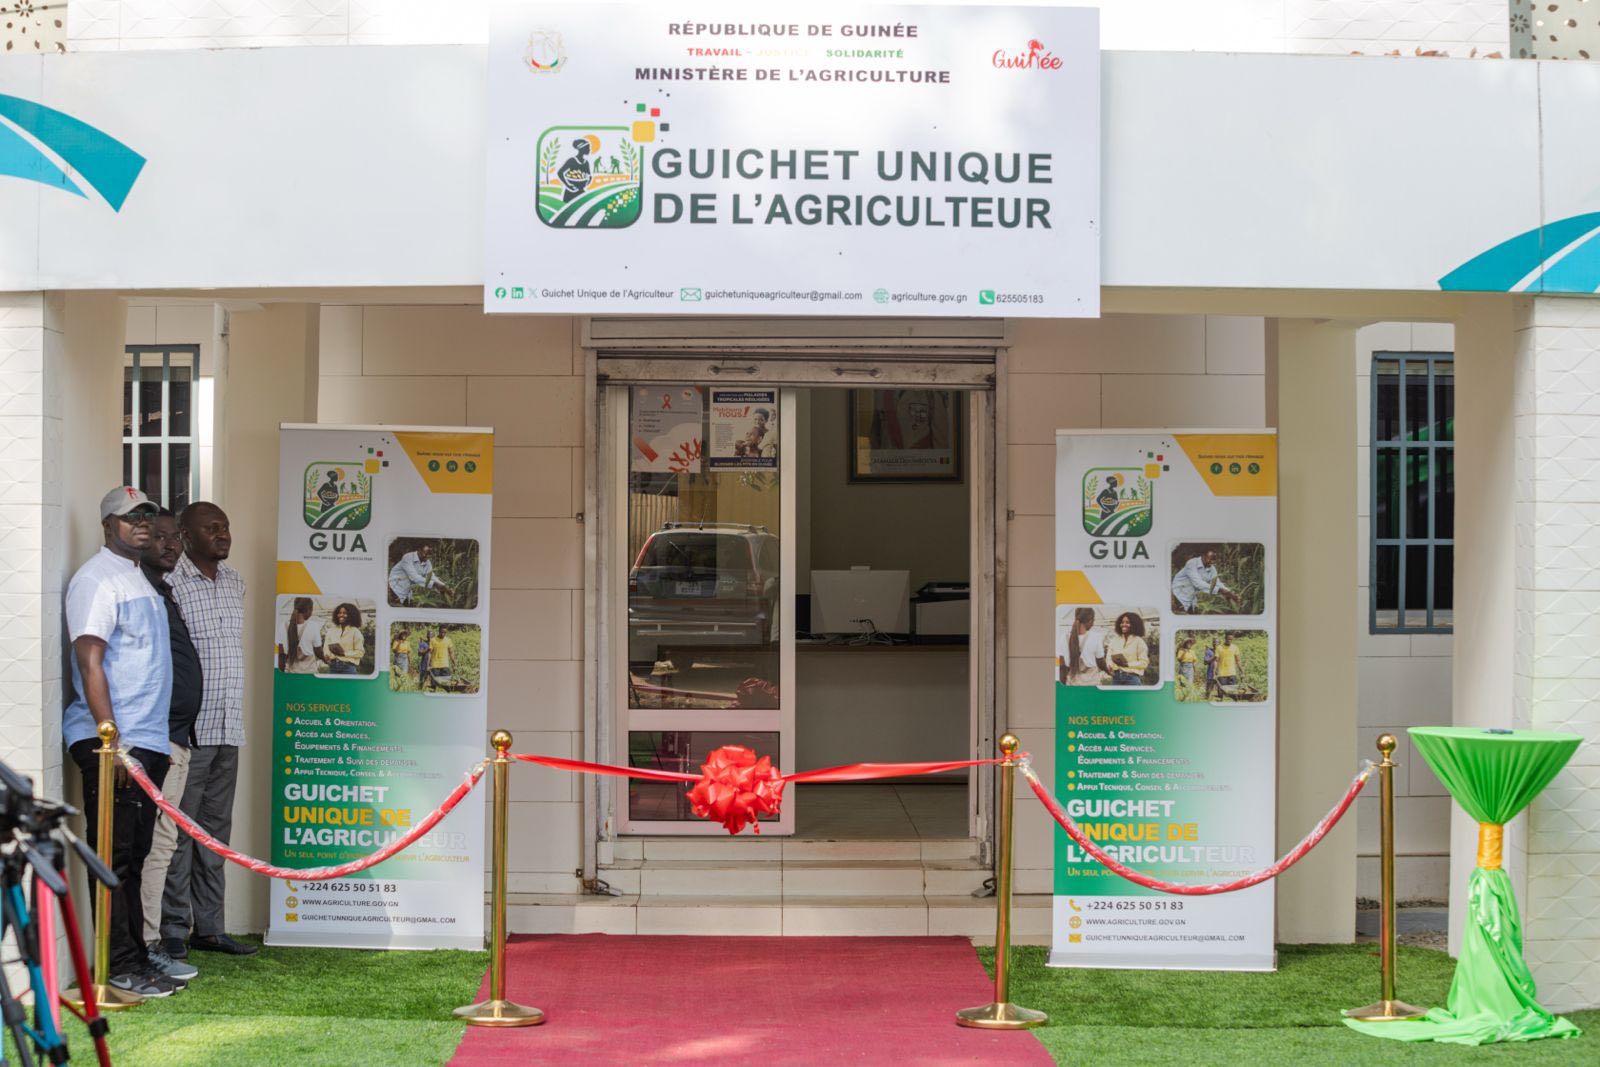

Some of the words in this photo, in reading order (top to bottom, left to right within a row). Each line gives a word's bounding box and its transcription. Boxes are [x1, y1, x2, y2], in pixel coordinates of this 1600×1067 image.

[669, 20, 799, 37] RÉPUBLIQUE
[808, 25, 832, 36] DE
[841, 22, 918, 38] GUINÉE
[687, 48, 742, 56] TRAVAIL
[826, 48, 904, 58] SOLIDARITÉ
[992, 39, 1063, 70] Guinée
[635, 66, 748, 81] MINISTÈRE
[756, 70, 780, 81] DE
[789, 69, 950, 83] L'AGRICULTURE
[651, 148, 859, 180] GUICHET
[877, 151, 1053, 185] UNIQUE
[653, 193, 718, 224] DE
[732, 193, 1052, 229] L'AGRICULTEUR
[542, 289, 574, 298] Guichet
[578, 290, 608, 300] Unique
[610, 290, 620, 298] de
[705, 290, 862, 301] guichetuniqueagriculteur@gmail.com
[891, 292, 968, 303] agriculture.gov.gn
[996, 294, 1044, 303] 625505183
[309, 532, 368, 552] GUA
[1089, 540, 1150, 560] GUA
[286, 704, 306, 712] NOS
[308, 704, 351, 712] SERVICES
[325, 718, 331, 726] &
[1068, 716, 1088, 725] NOS
[1091, 716, 1136, 725] SERVICES
[1108, 731, 1116, 739] &
[343, 743, 350, 751] &
[1128, 756, 1134, 764] &
[1122, 770, 1128, 778] &
[284, 783, 389, 803] GUICHET
[1067, 799, 1175, 818] GUICHET
[284, 806, 374, 826] UNIQUE
[380, 808, 411, 826] DE
[284, 827, 466, 849] L'AGRICULEUR
[1167, 824, 1199, 841] DE
[302, 883, 328, 892] +224
[330, 883, 350, 892] 625
[353, 884, 366, 892] 50
[368, 884, 380, 893] 51
[384, 884, 396, 893] 83
[302, 899, 399, 907] WWW.AGRICULTURE.GOV.GN
[1086, 901, 1113, 910] +224
[1116, 901, 1136, 910] 625
[1139, 901, 1152, 910] 50
[1154, 901, 1166, 910] 51
[1170, 901, 1184, 910] 83
